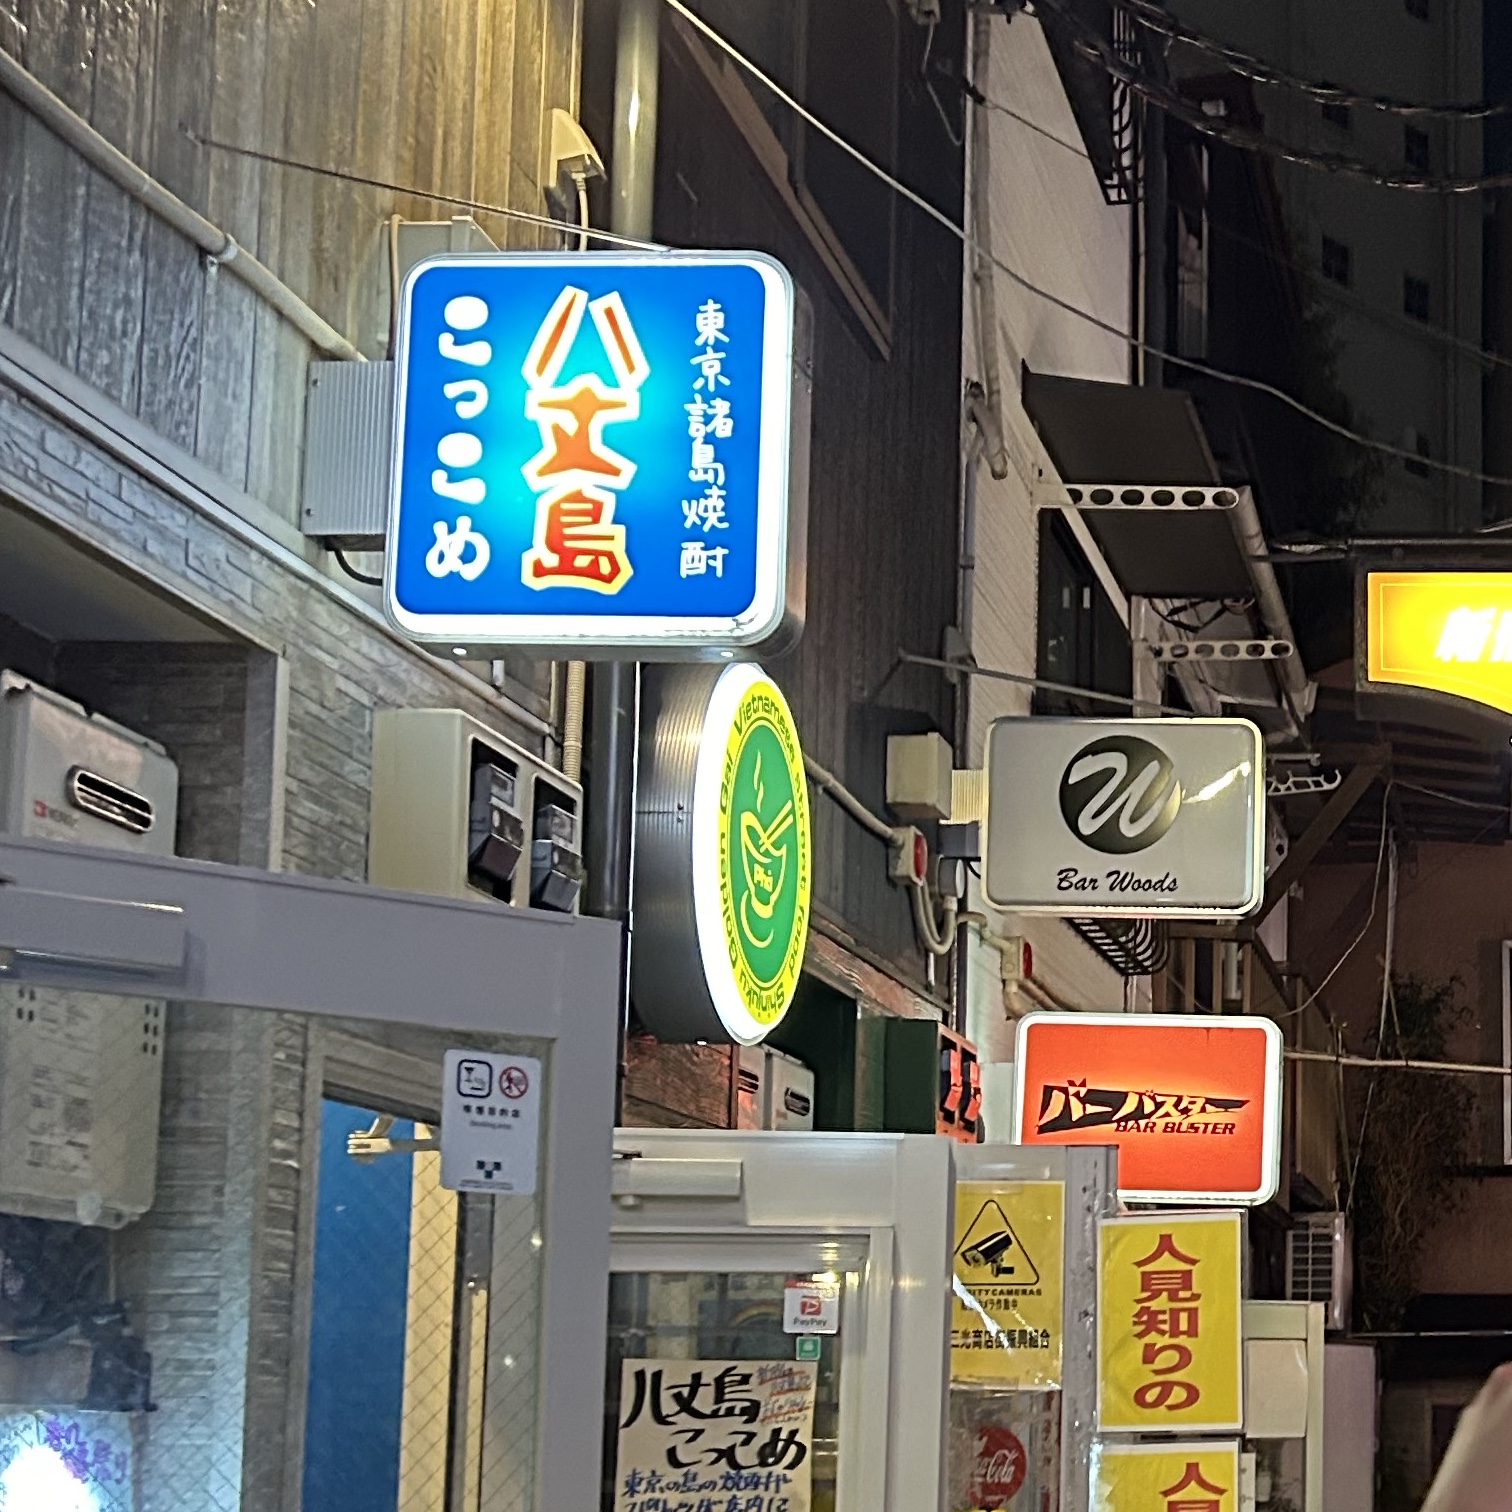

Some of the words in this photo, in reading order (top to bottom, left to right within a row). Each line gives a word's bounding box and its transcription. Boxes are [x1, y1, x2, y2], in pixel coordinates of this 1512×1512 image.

[425, 296, 492, 581] こっこめ
[523, 286, 650, 594] 八丈島
[680, 298, 733, 578] 東京諸島焼酎
[1056, 868, 1099, 891] Bar
[1106, 870, 1178, 892] Woods
[1038, 1078, 1246, 1123] バーバスター
[1114, 1120, 1155, 1133] BAR
[1162, 1122, 1236, 1135] BUSTER
[793, 1316, 827, 1326] PayPay
[1133, 1234, 1201, 1411] 人見知りの
[619, 1365, 761, 1429] 八丈島
[666, 1427, 807, 1470] こっこめ
